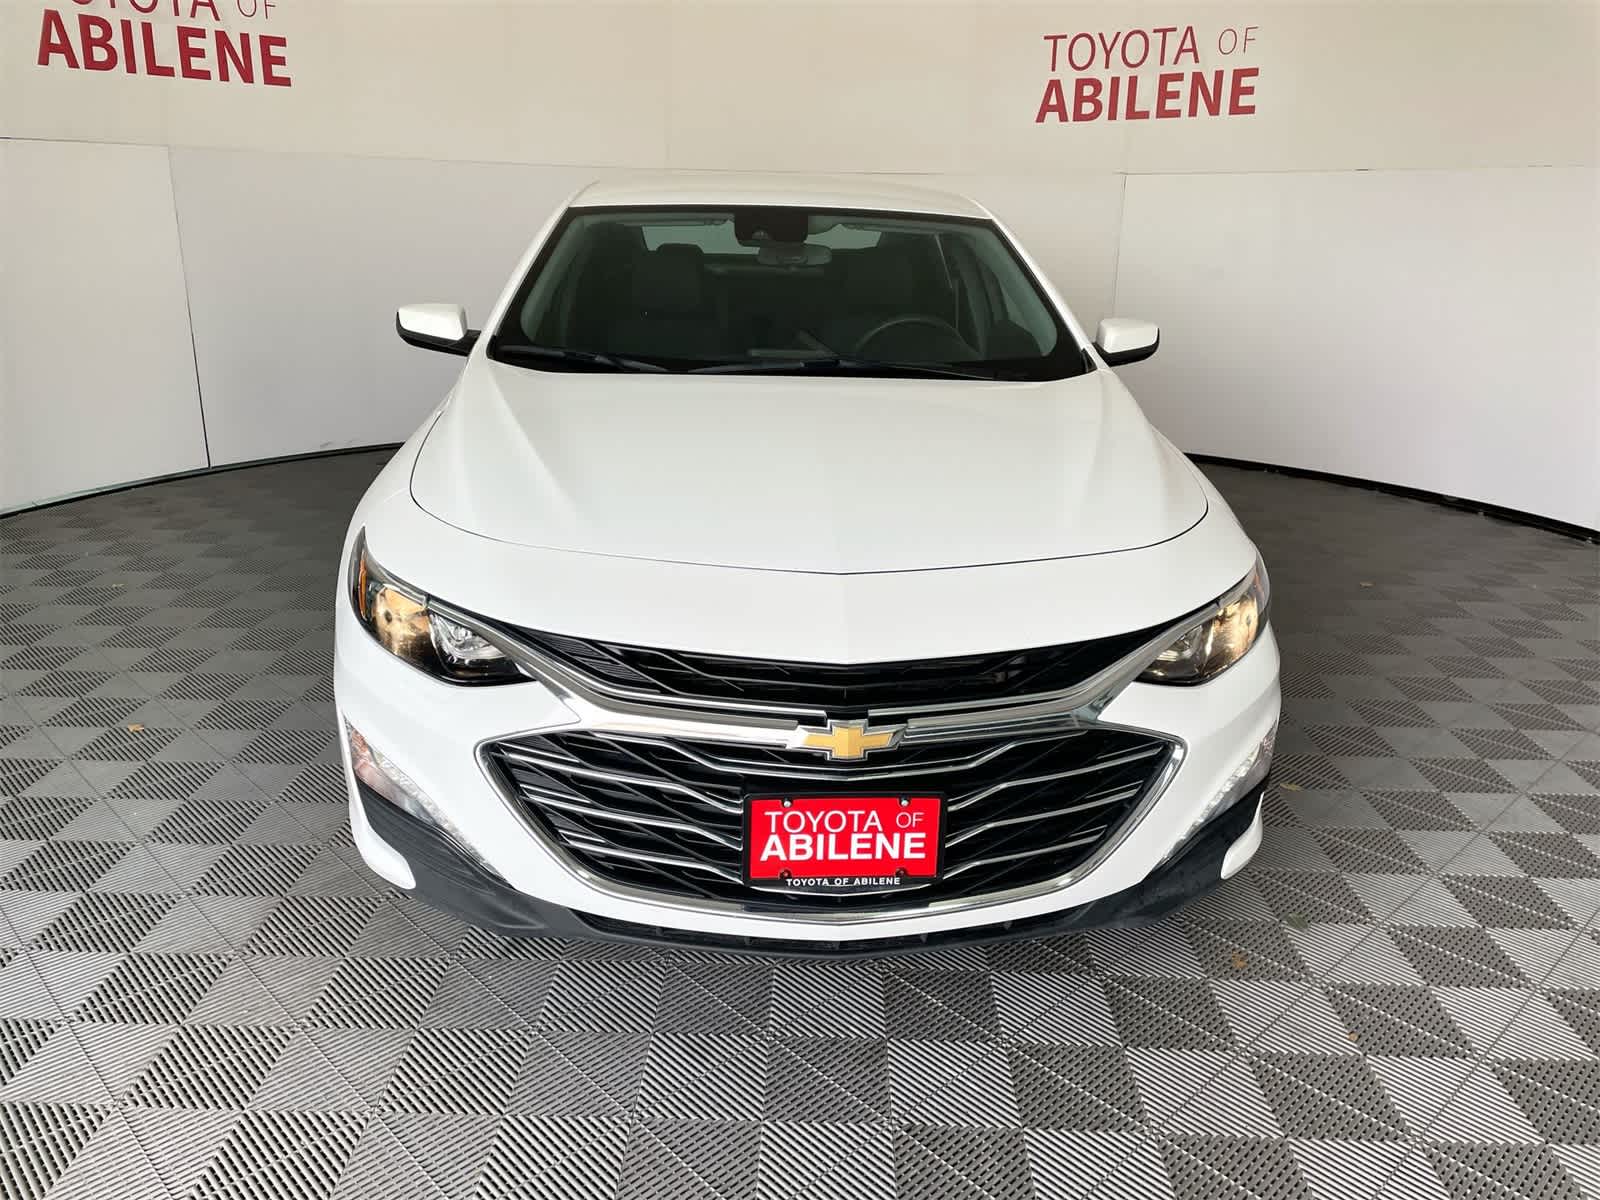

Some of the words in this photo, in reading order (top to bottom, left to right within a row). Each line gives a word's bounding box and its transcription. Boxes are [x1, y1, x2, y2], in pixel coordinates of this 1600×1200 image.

[37, 9, 292, 87] ABILENE
[1043, 25, 1200, 72] TOYOTA
[1218, 26, 1259, 55] OF
[1035, 67, 1259, 123] ABILENE
[764, 810, 883, 833] TOYOTA
[896, 811, 925, 829] OF
[760, 832, 926, 861] ABILENE
[786, 878, 829, 886] TOYOTA
[834, 878, 849, 886] OF
[854, 877, 900, 885] ABILENE
